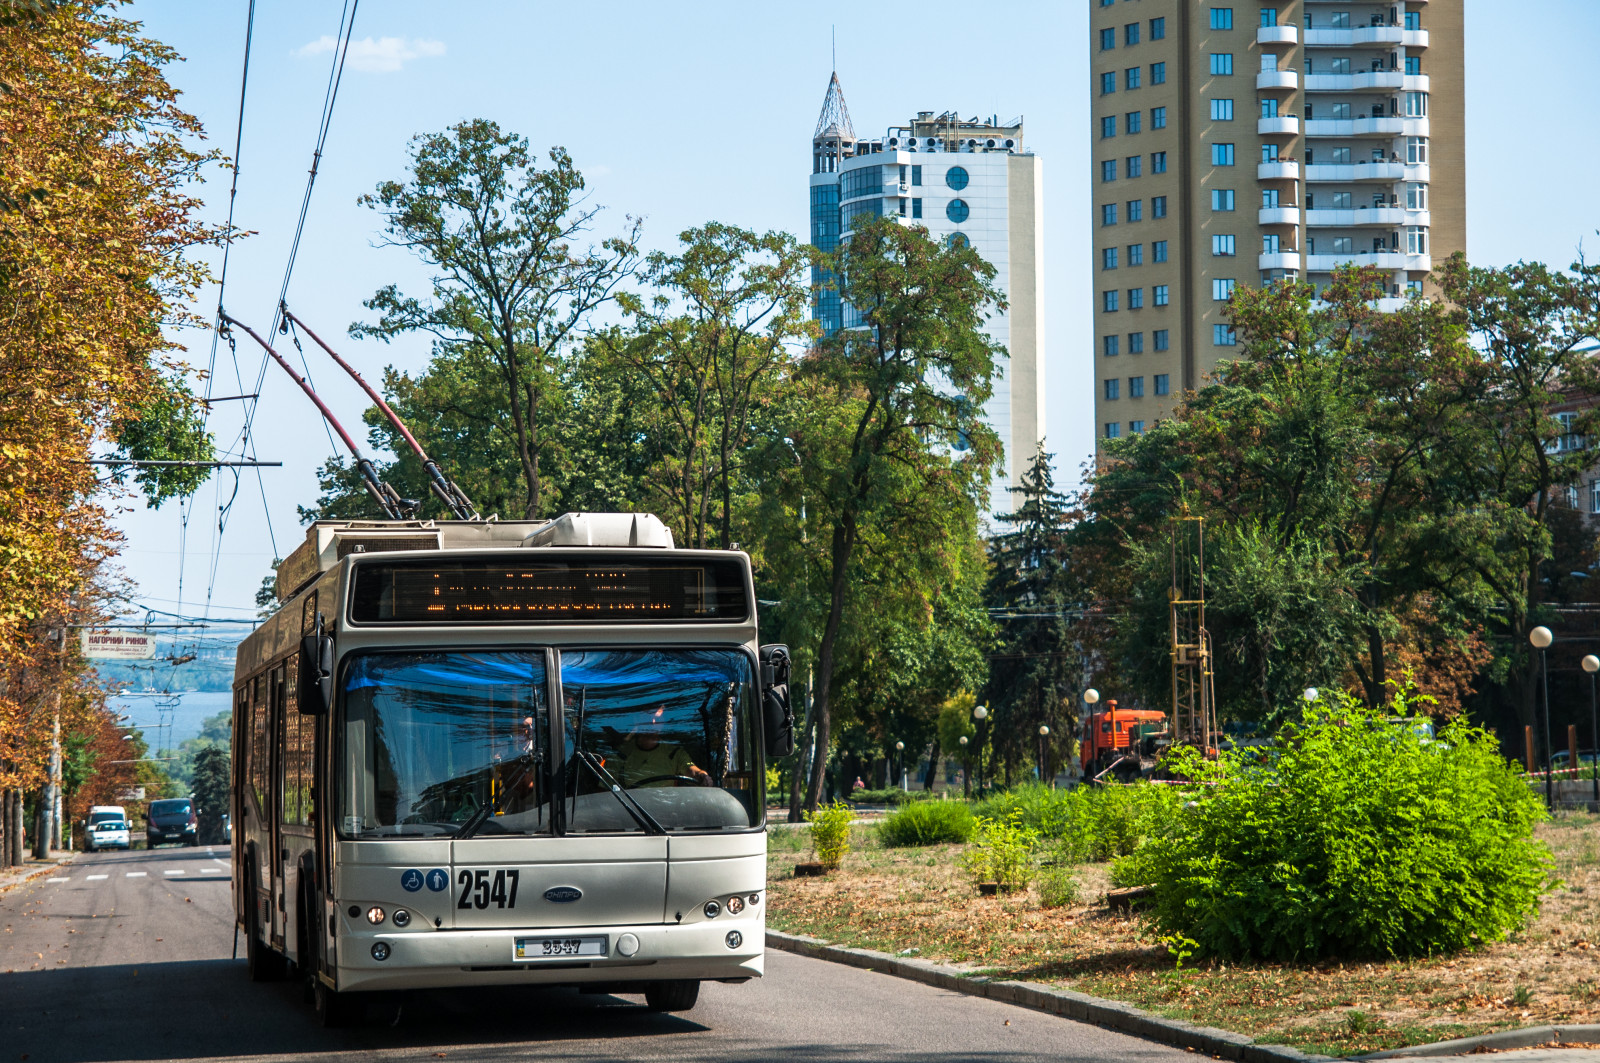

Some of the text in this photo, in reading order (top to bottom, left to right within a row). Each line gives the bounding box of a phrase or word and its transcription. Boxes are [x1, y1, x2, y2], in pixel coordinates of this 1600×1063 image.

[88, 635, 148, 645] НАГОРНИЙ РИНОК
[457, 869, 520, 910] 2547
[542, 939, 582, 955] 2547
